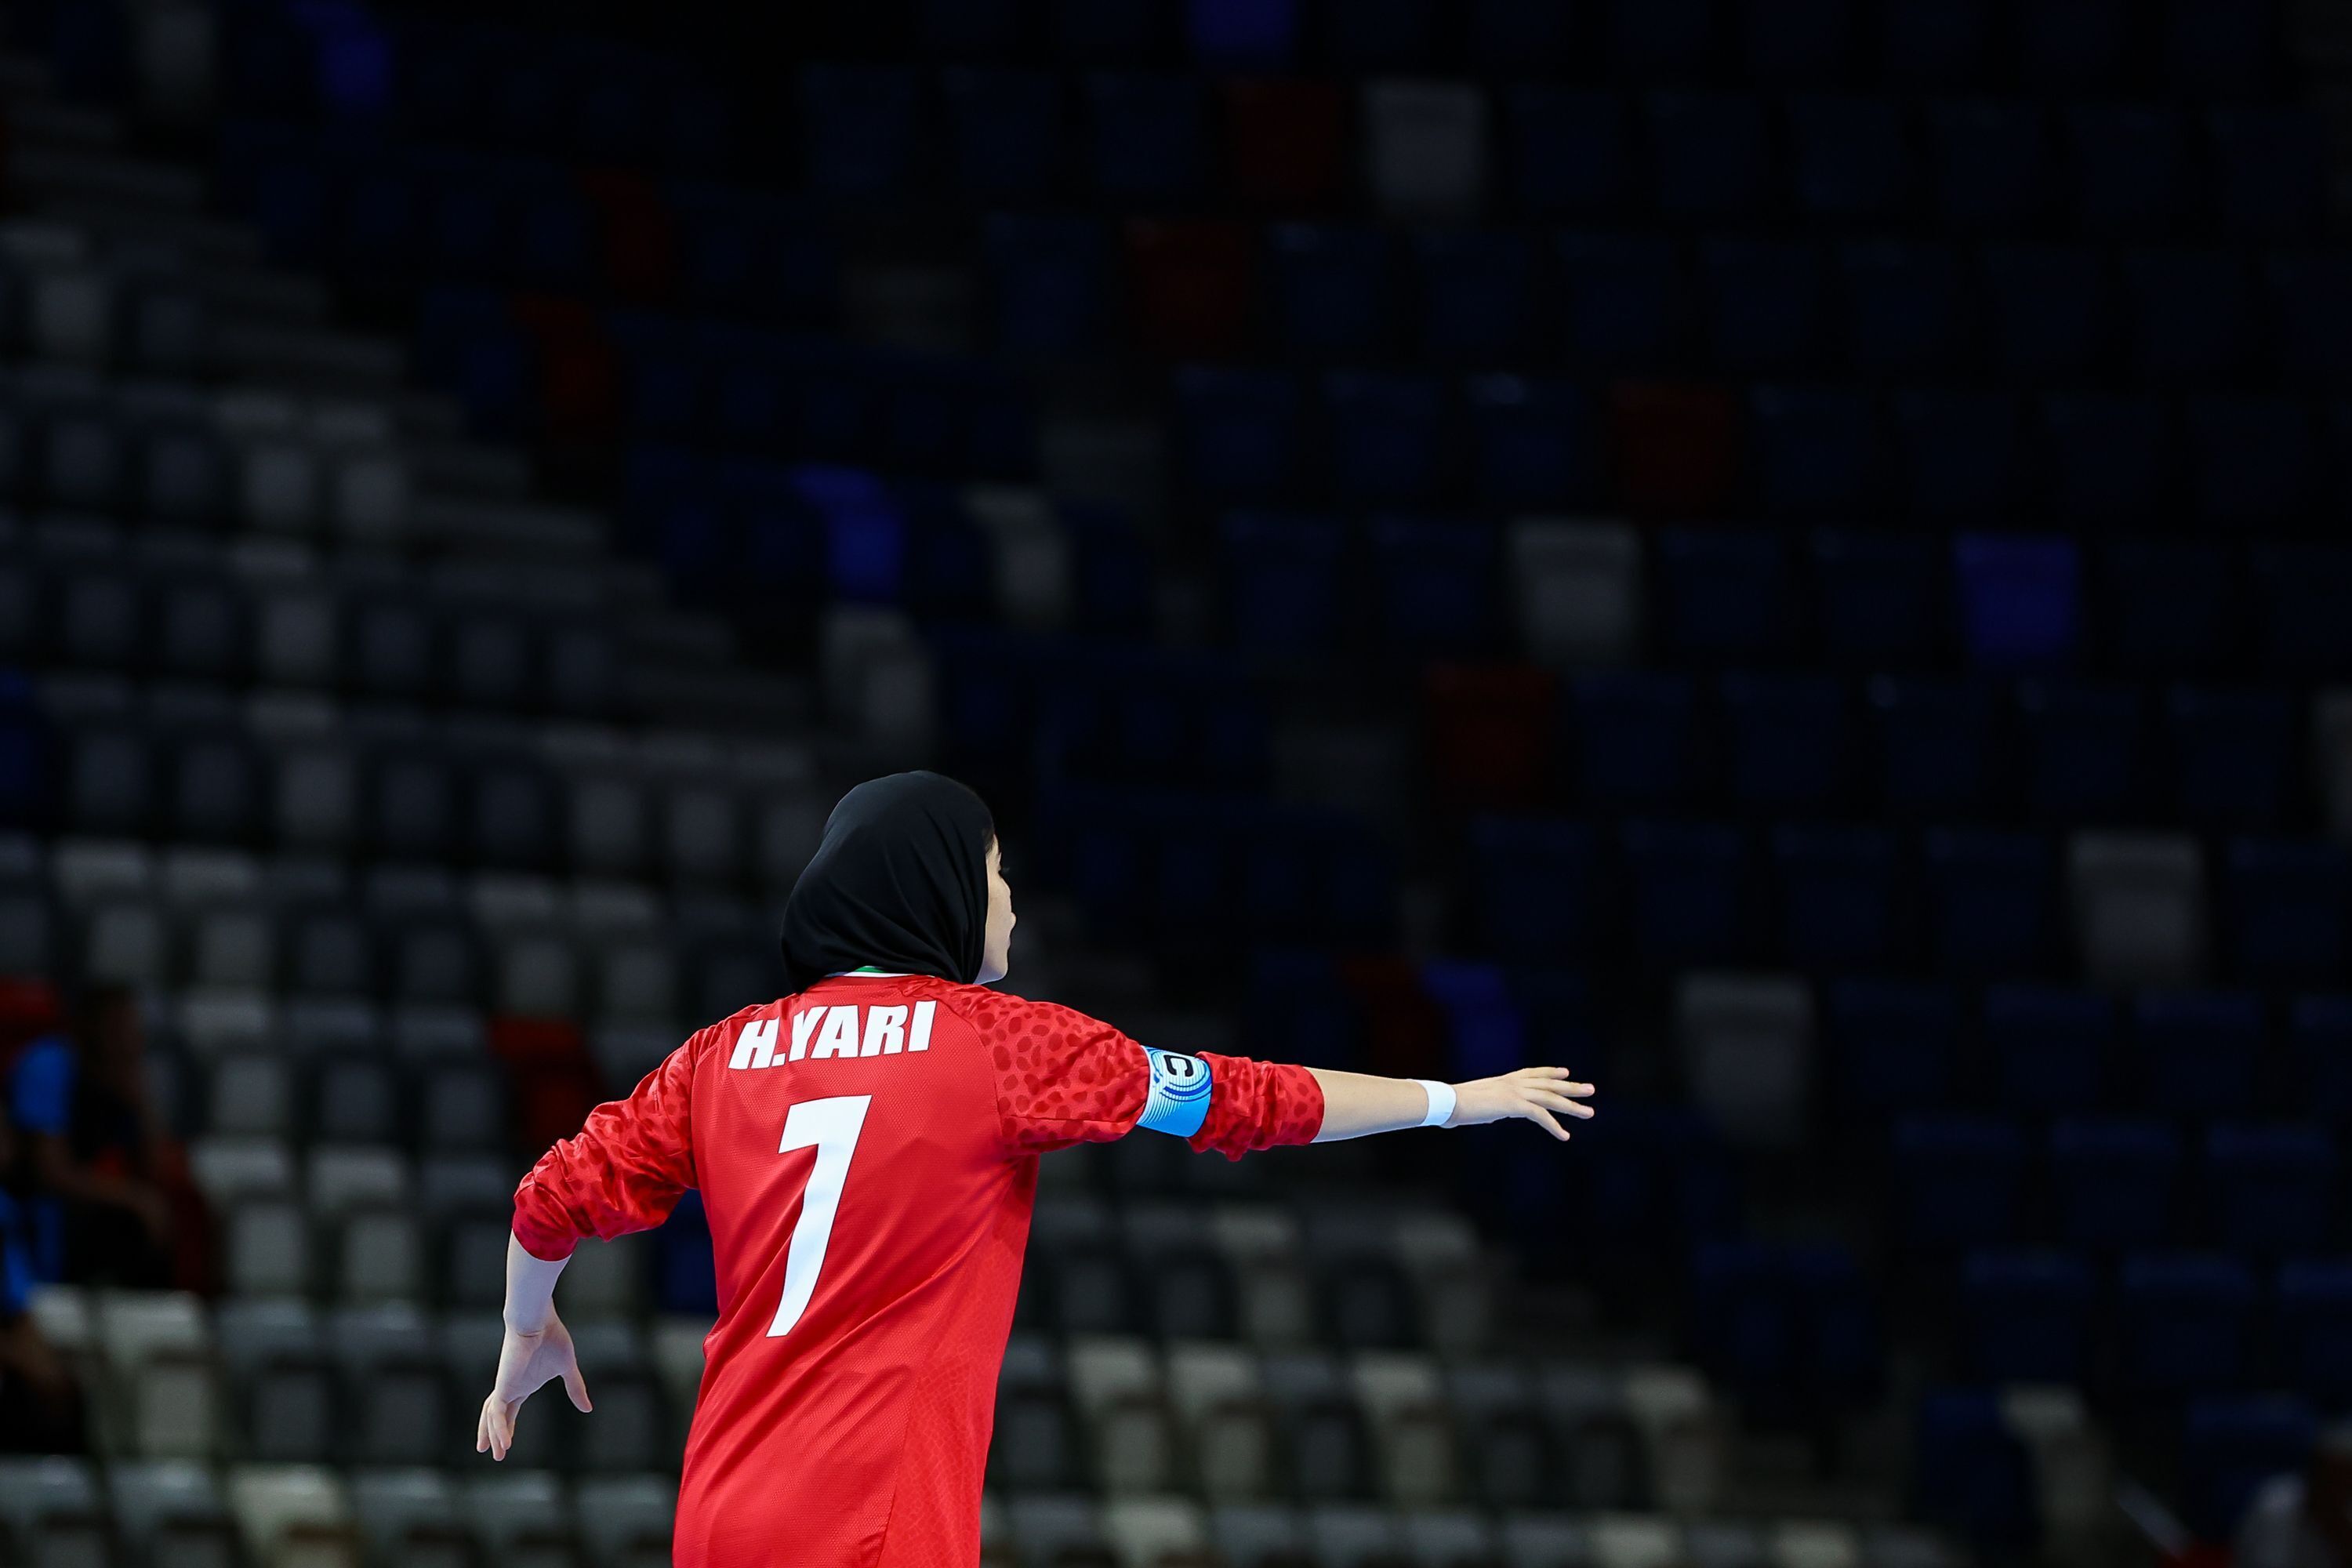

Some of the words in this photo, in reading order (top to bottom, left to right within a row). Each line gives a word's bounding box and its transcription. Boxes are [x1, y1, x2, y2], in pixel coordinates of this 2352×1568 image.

[728, 1000, 937, 1070] H.YARI
[1163, 1054, 1194, 1077] C
[765, 1094, 873, 1338] 7
